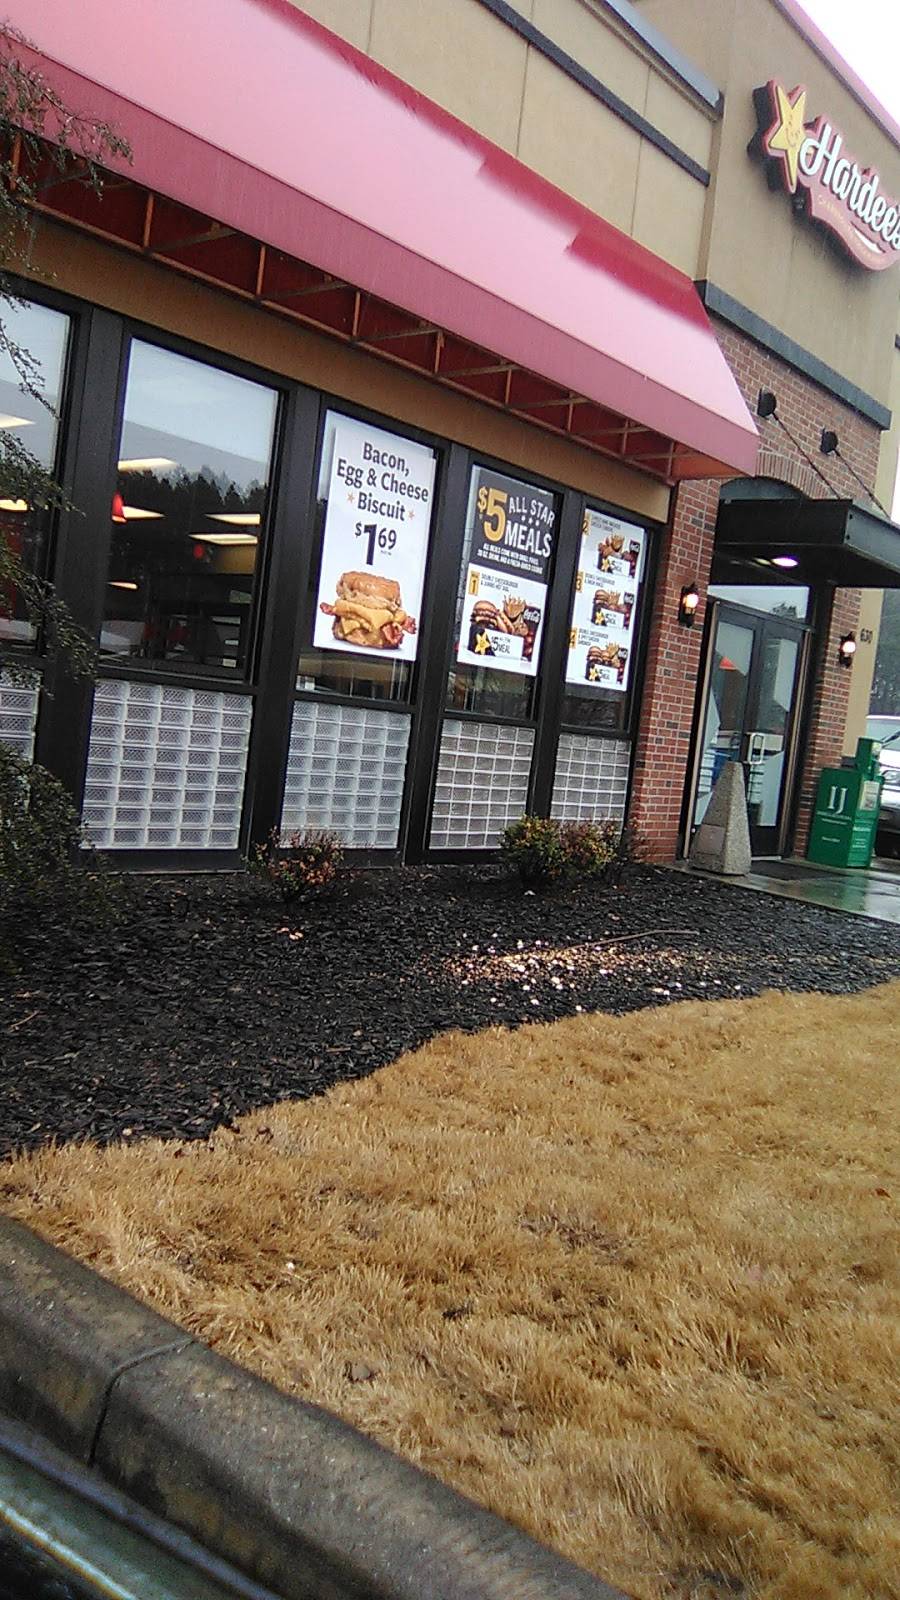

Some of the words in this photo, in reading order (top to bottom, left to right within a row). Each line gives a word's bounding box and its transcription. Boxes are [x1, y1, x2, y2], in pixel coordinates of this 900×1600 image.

[362, 441, 410, 477] Bacon,
[336, 458, 364, 489] Egg
[366, 467, 378, 488] &
[380, 472, 430, 502] Cheese
[357, 491, 406, 522] Biscuit
[477, 486, 508, 542] $5
[508, 496, 528, 514] ALL
[530, 499, 556, 528] STAR
[504, 520, 552, 558] MEALS
[827, 785, 848, 816] IJ
